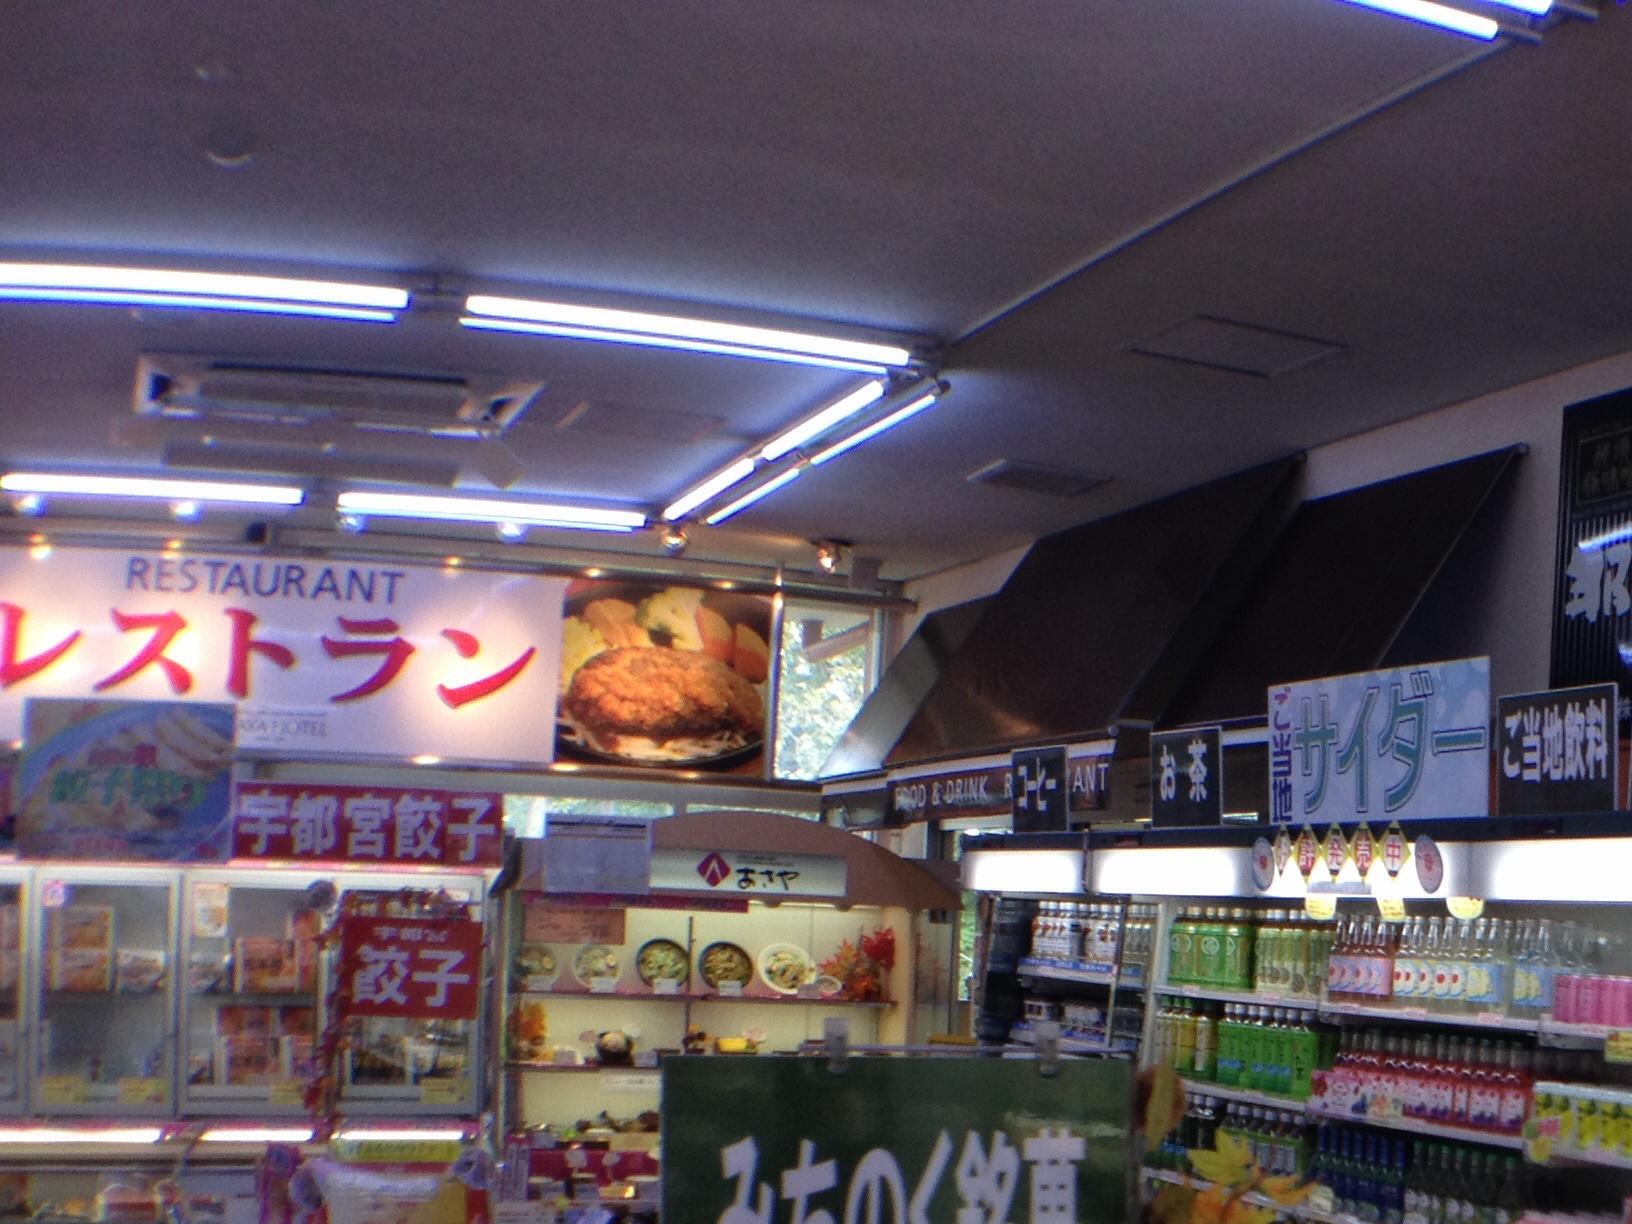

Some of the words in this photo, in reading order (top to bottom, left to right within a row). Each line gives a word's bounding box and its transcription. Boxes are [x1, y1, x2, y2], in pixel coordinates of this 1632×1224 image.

[125, 556, 405, 604] RESTAURANT
[0, 606, 538, 710] レストラン
[1294, 670, 1487, 815] サイダー
[1503, 698, 1608, 784] ご当地飲料
[240, 791, 496, 861] 宇都宮餃子
[736, 867, 800, 891] あさや
[351, 943, 470, 1007] 餃子
